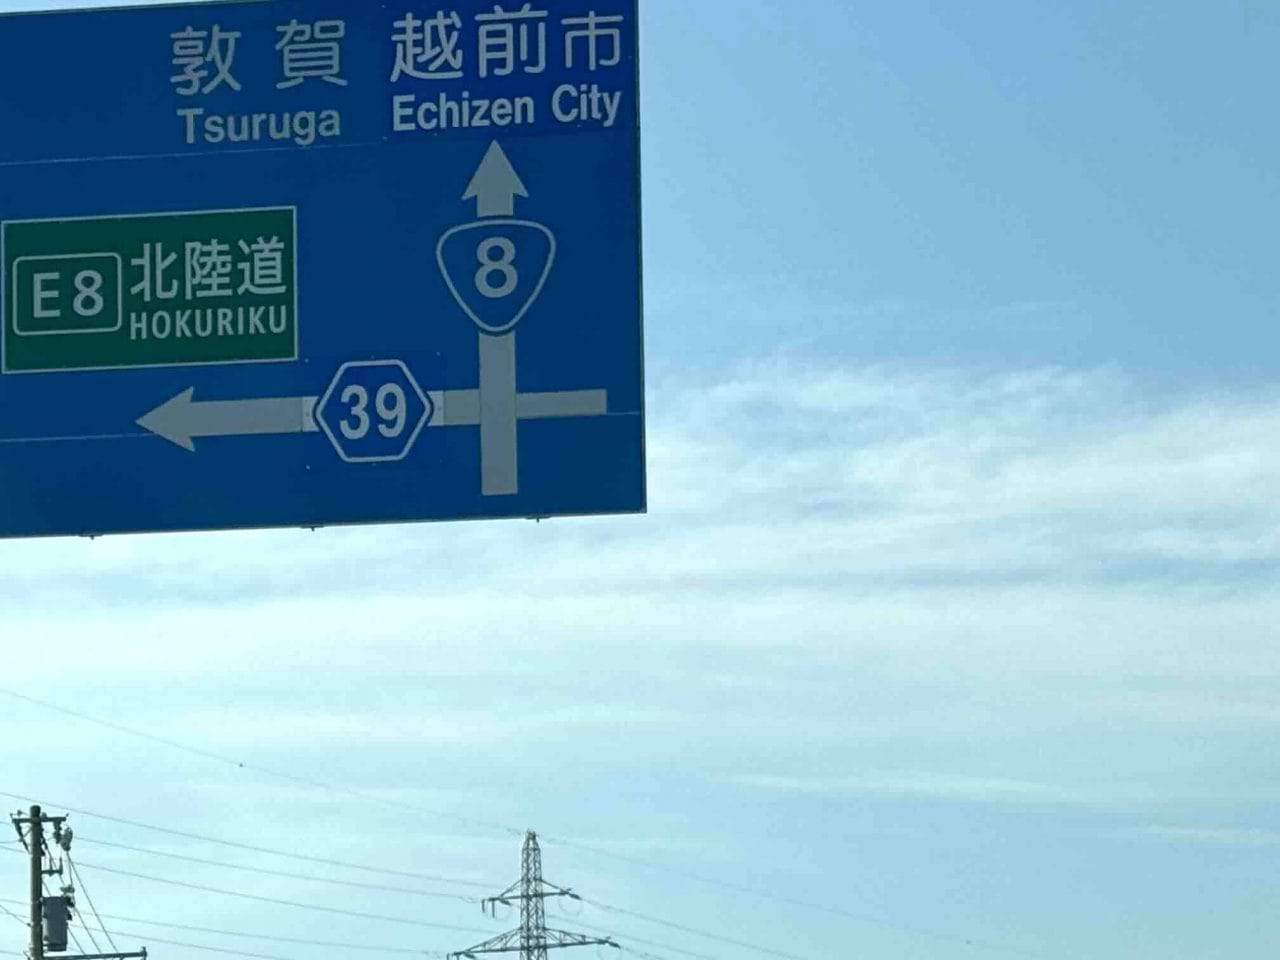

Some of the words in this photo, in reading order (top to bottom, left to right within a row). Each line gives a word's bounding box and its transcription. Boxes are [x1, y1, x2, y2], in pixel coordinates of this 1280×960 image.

[170, 19, 348, 96] 敦賀
[390, 5, 624, 83] 越前市
[177, 108, 341, 145] Tsuruga
[392, 91, 535, 132] Echizen
[551, 84, 621, 126] City
[130, 236, 287, 302] 北陸道
[474, 236, 518, 298] 8
[130, 305, 287, 340] HOKURIKU
[339, 383, 408, 440] 39
